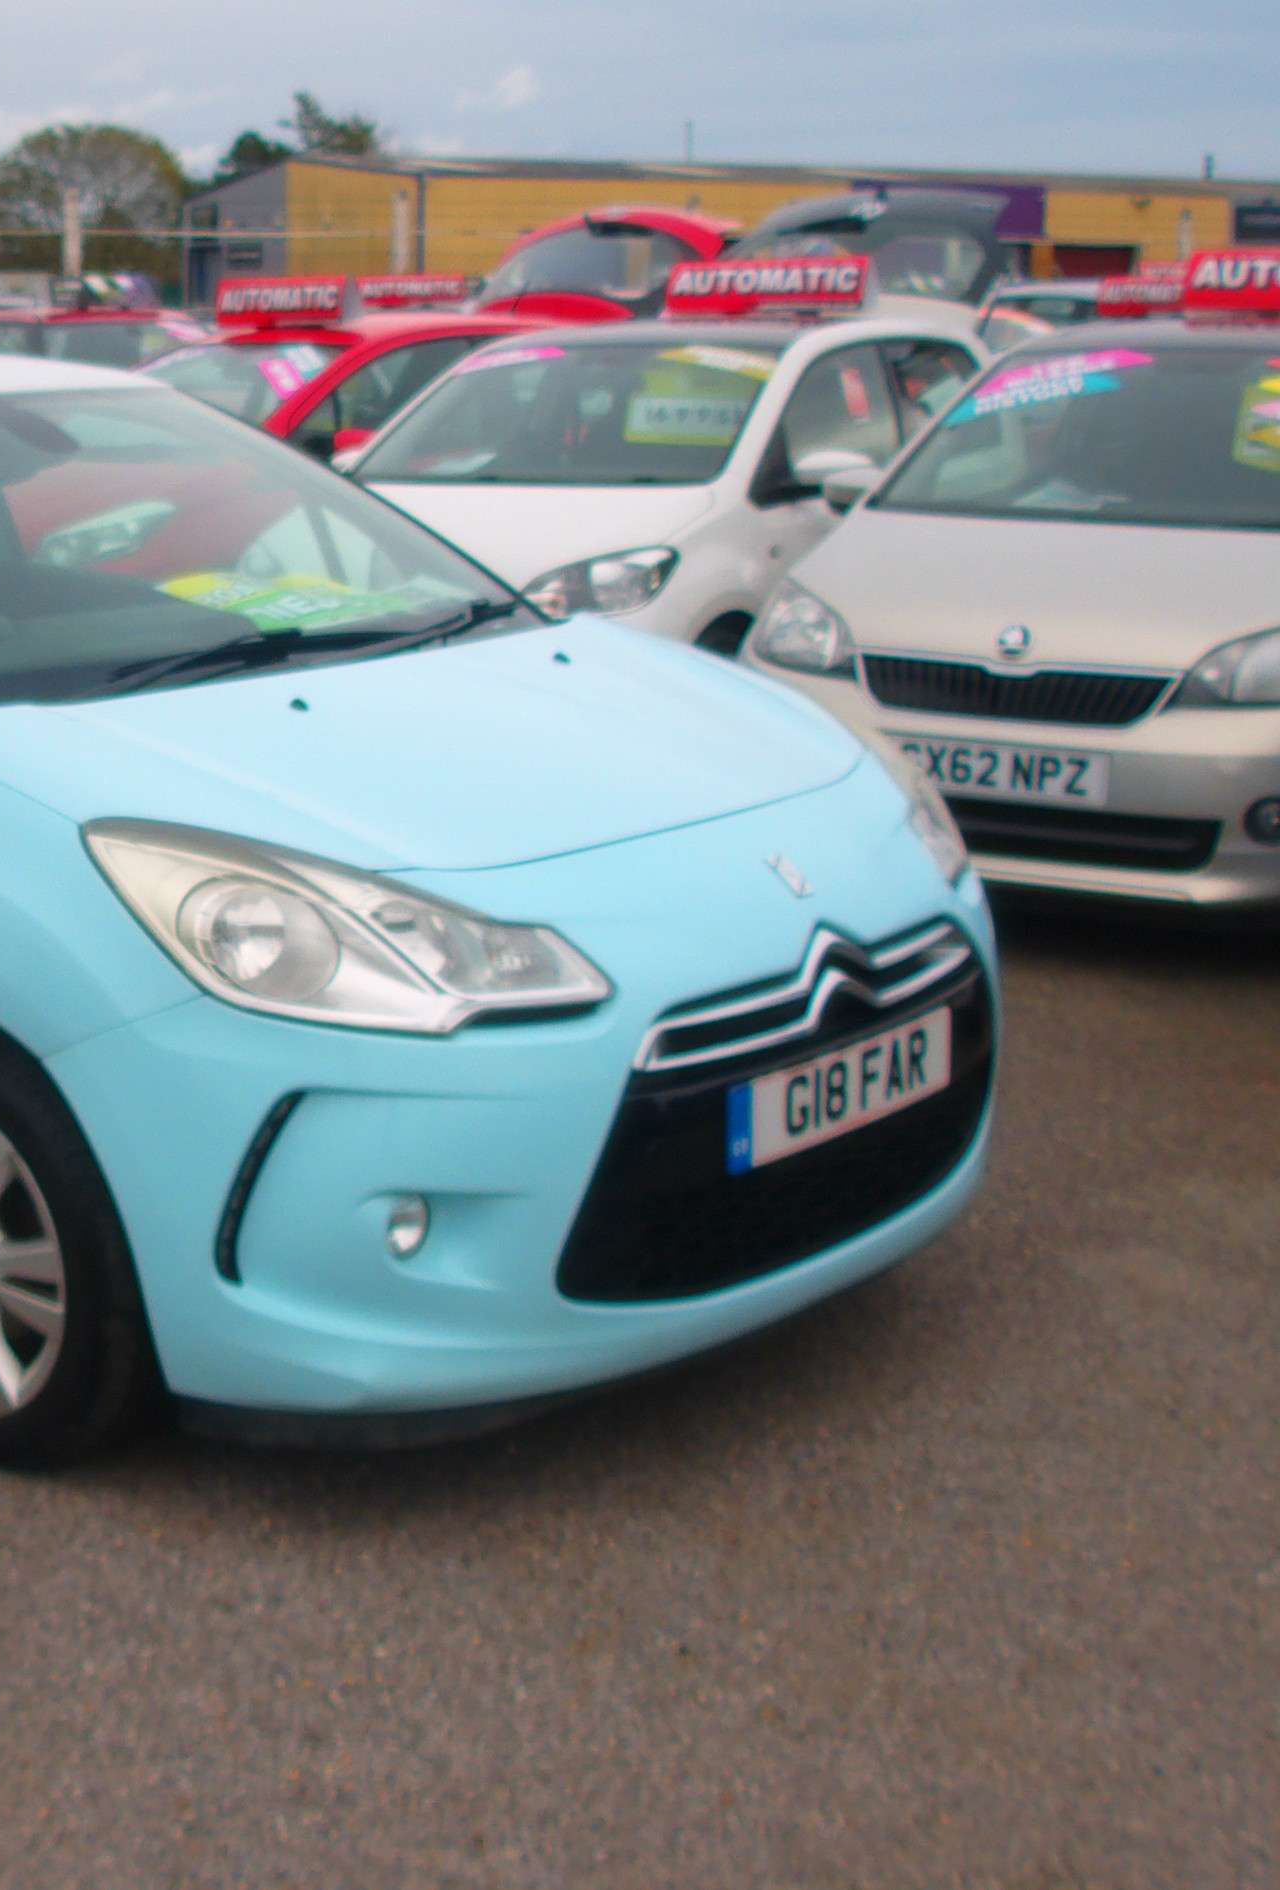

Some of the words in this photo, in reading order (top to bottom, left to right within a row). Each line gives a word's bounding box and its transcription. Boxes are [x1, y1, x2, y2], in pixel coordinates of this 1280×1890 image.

[361, 279, 460, 298] AUTOMATIC
[672, 265, 859, 296] AUTOMATIC
[1191, 255, 1280, 290] AUT
[221, 284, 339, 312] AUTOMATIC
[1010, 752, 1089, 797] NPZ
[785, 1060, 848, 1137] G18
[860, 1028, 928, 1110] FAR
